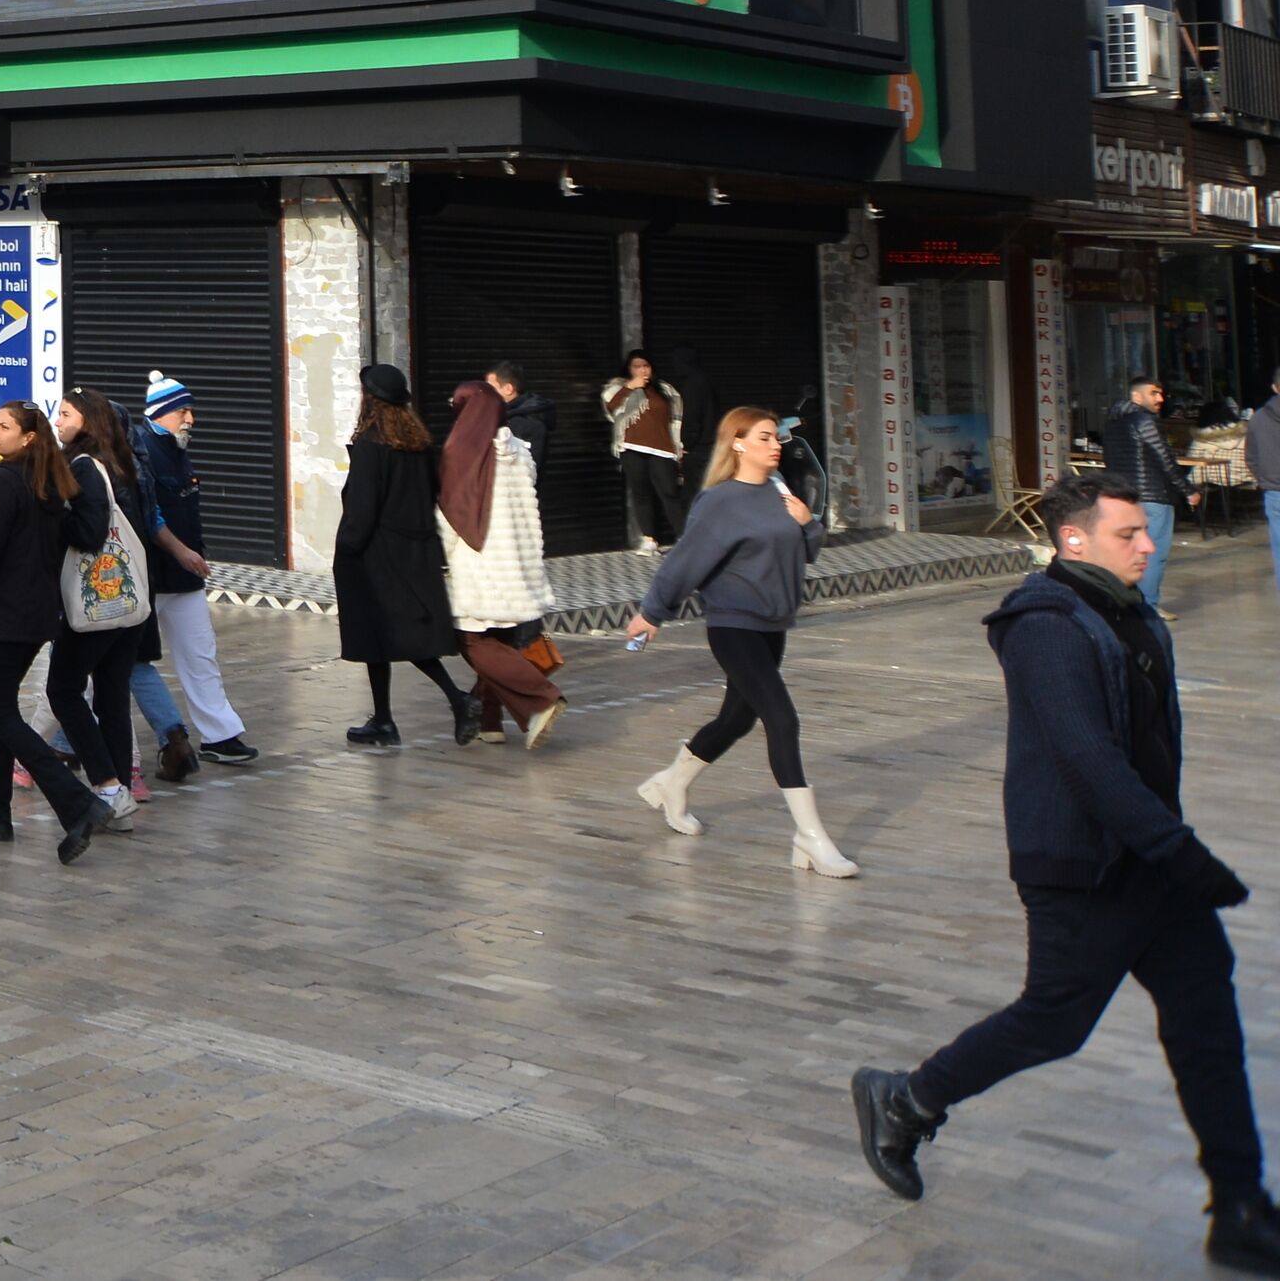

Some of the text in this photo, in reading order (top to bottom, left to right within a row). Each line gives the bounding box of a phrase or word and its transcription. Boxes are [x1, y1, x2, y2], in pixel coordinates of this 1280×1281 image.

[6, 279, 28, 292] hali
[43, 330, 57, 419] Pay
[1042, 418, 1057, 491] YOLLA
